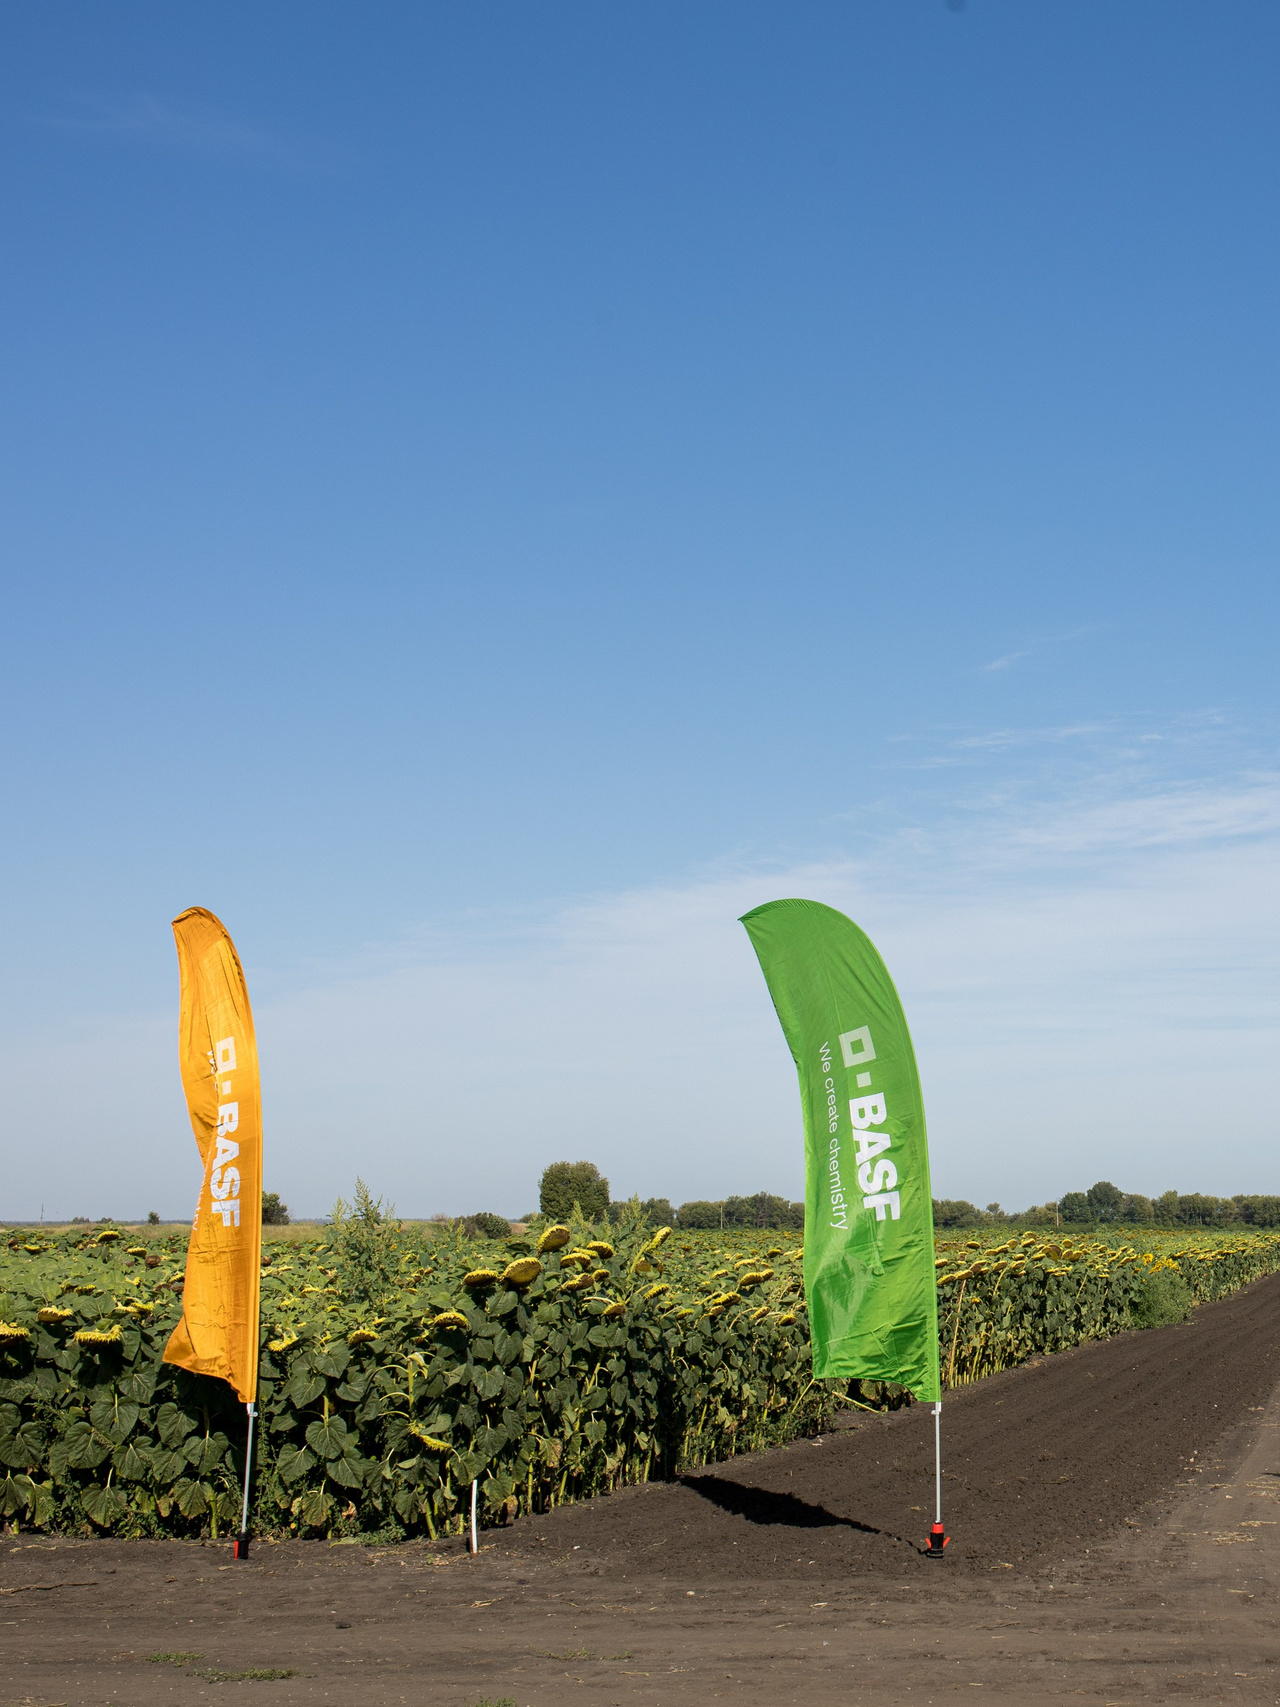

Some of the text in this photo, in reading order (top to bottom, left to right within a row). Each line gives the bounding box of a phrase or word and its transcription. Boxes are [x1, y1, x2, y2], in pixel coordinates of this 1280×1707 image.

[210, 1102, 241, 1227] BASF
[819, 1041, 848, 1230] We create chemistry
[849, 1092, 901, 1222] BASF
